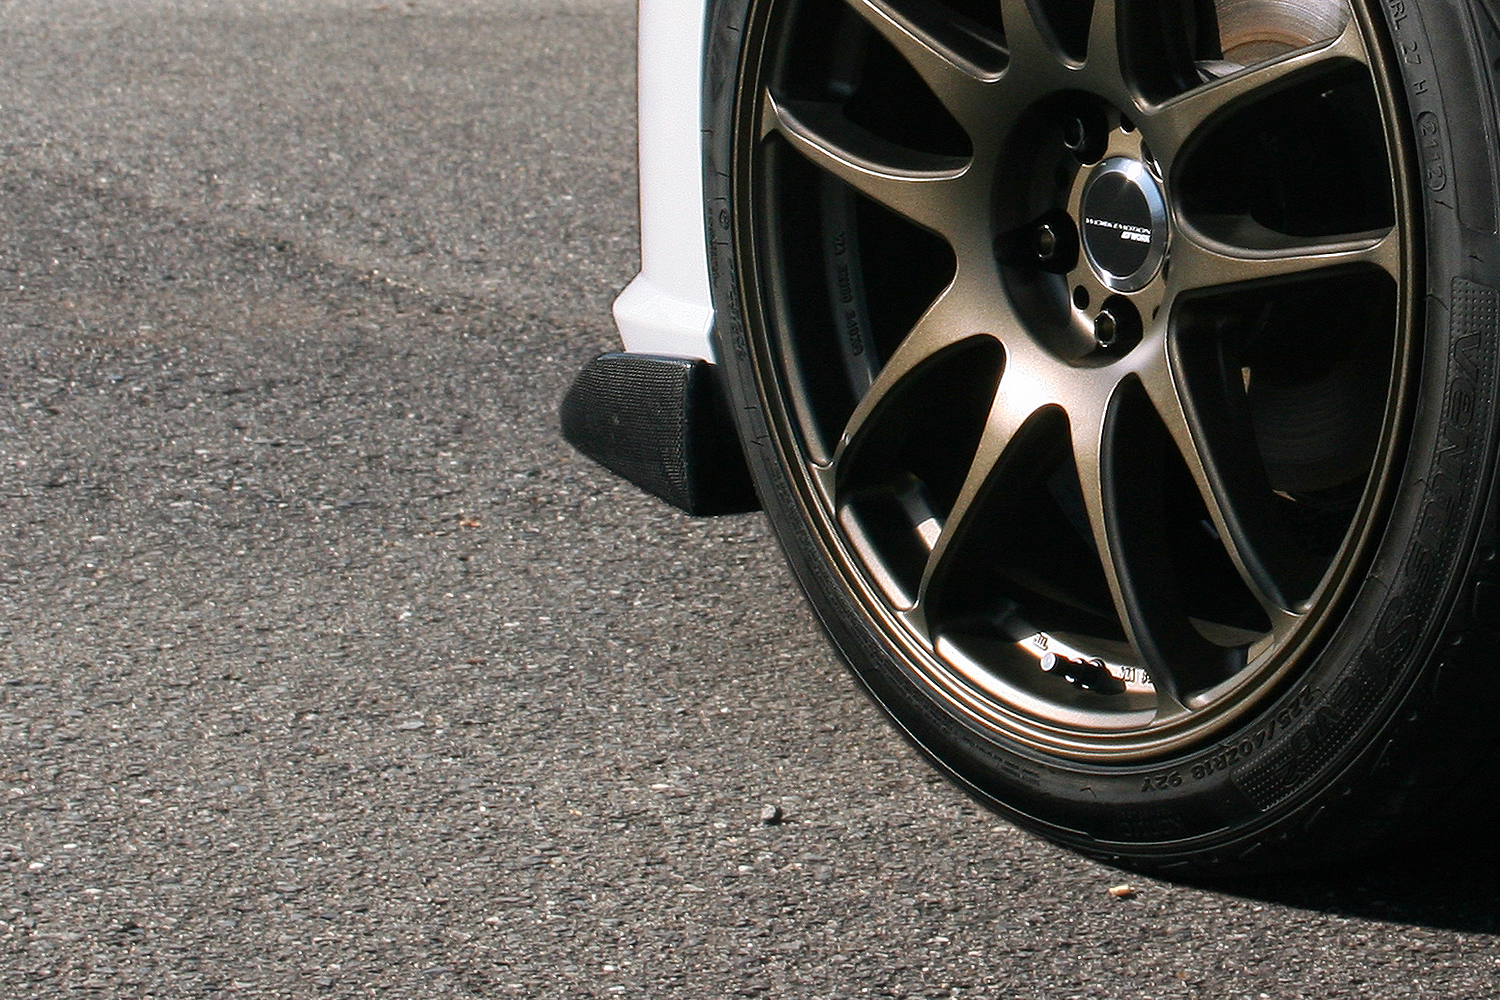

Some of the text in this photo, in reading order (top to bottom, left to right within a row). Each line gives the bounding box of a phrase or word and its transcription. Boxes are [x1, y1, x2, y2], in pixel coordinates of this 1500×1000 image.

[1401, 41, 1421, 66] 27
[1412, 79, 1429, 97] H
[1419, 120, 1446, 188] 2112
